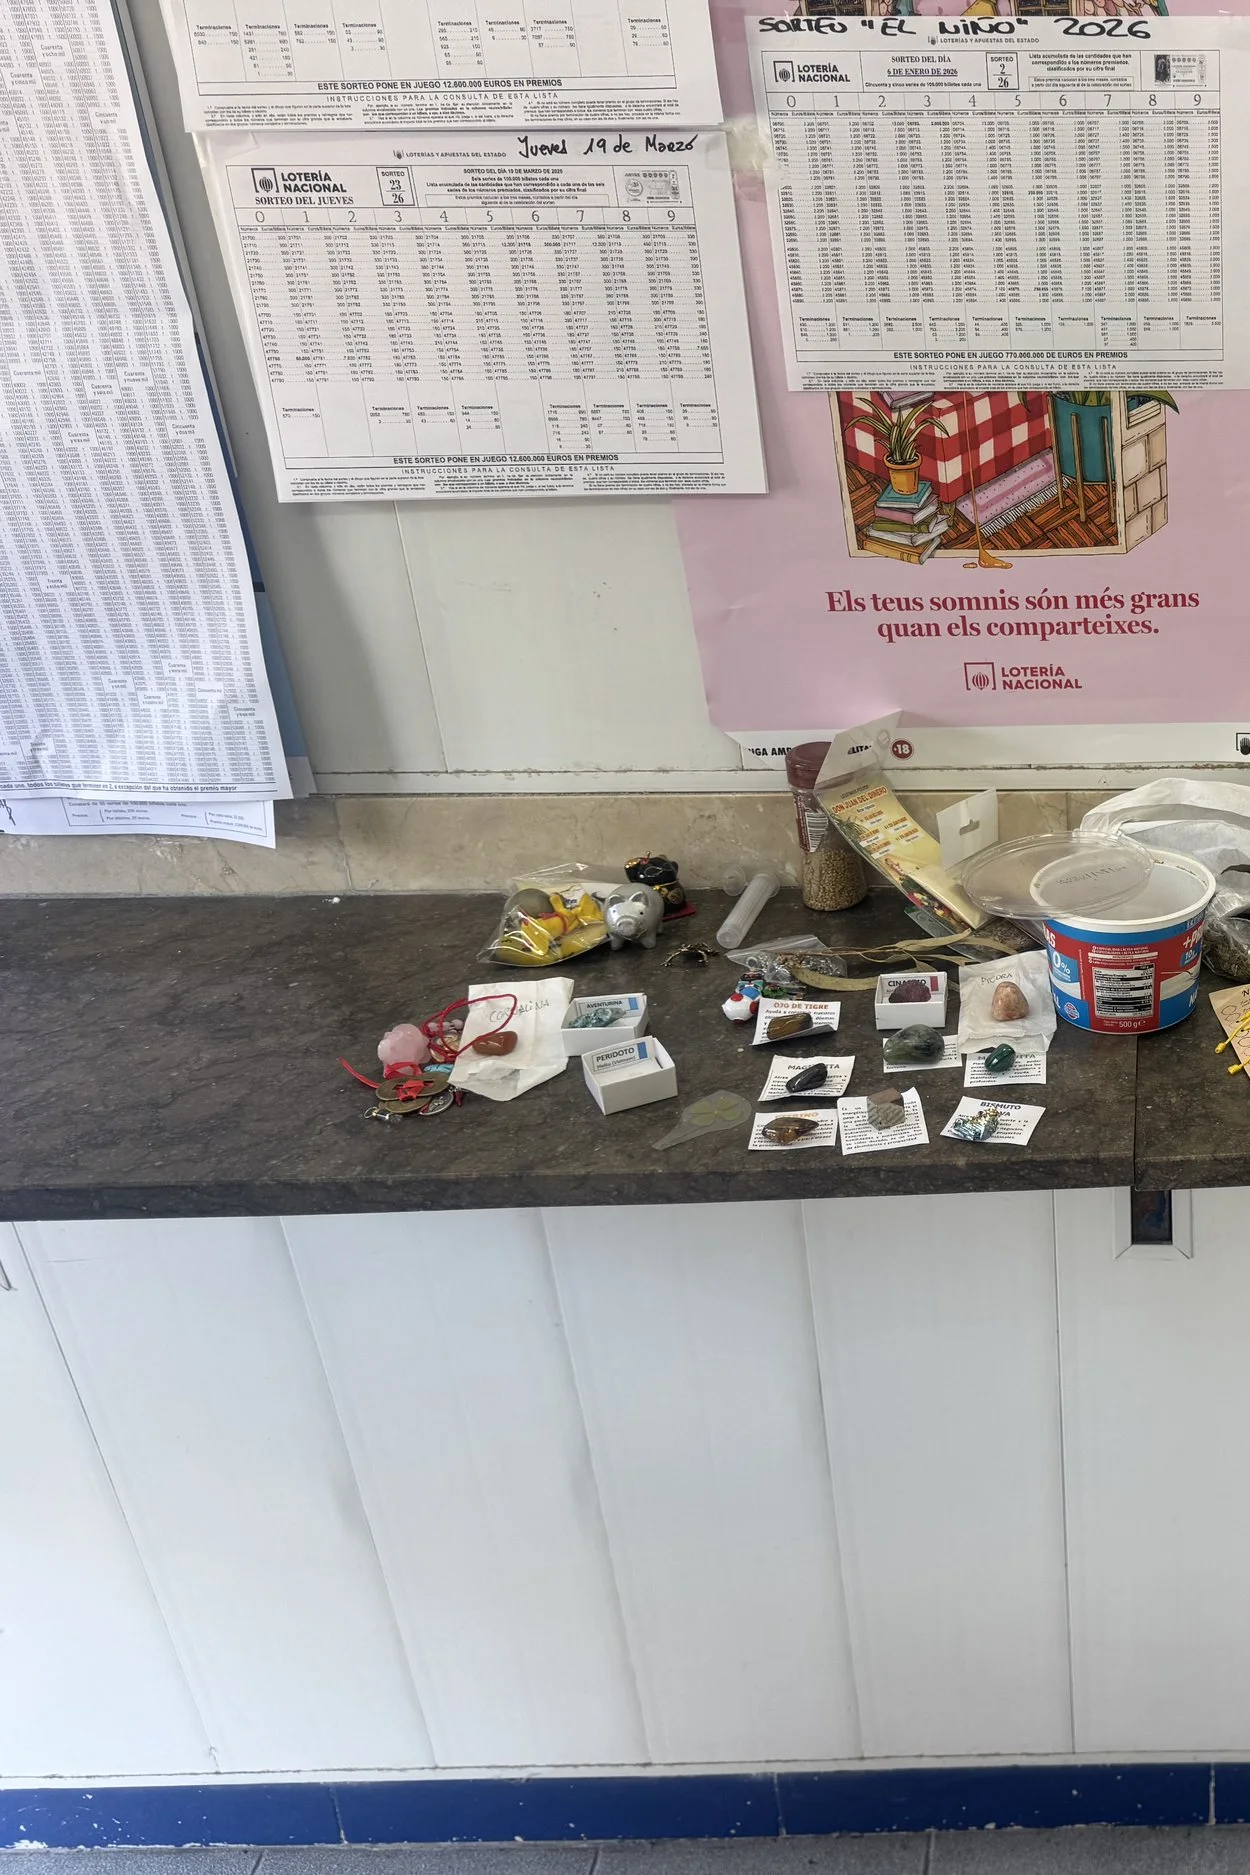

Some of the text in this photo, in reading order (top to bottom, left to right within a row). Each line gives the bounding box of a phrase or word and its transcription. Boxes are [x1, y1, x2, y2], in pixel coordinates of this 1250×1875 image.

[1053, 17, 1151, 39] 2026
[938, 54, 952, 62] DÍA
[797, 63, 839, 73] LOTERÍA
[1000, 64, 1006, 74] 2
[798, 73, 850, 82] NACIONAL
[998, 77, 1009, 88] 26
[340, 82, 374, 90] SORTEO
[413, 81, 440, 89] JUEGO
[484, 80, 512, 88] EUROS
[526, 79, 562, 87] PREMIOS
[786, 94, 1201, 107] 0 1 2 3 4 5 6 7 8 9
[583, 137, 606, 155] 19
[613, 134, 632, 153] de
[280, 170, 332, 182] LOTERÍA
[284, 183, 347, 193] NACIONAL
[389, 179, 402, 191] 23
[255, 196, 354, 205] SORTEO DEL JUEVES
[392, 193, 404, 204] 26
[255, 210, 676, 223] 0 1 2 3 4 5 6 7 8 9
[586, 454, 619, 462] PREMIOS
[825, 586, 1200, 614] Els teus somnis són més grans
[877, 614, 1160, 644] quan els comparteixes.
[1002, 664, 1066, 677] LOTERÍA
[1002, 678, 1082, 690] NACIONAL
[586, 1000, 623, 1009] AVENTURINA
[596, 1047, 635, 1062] PERIDOTO
